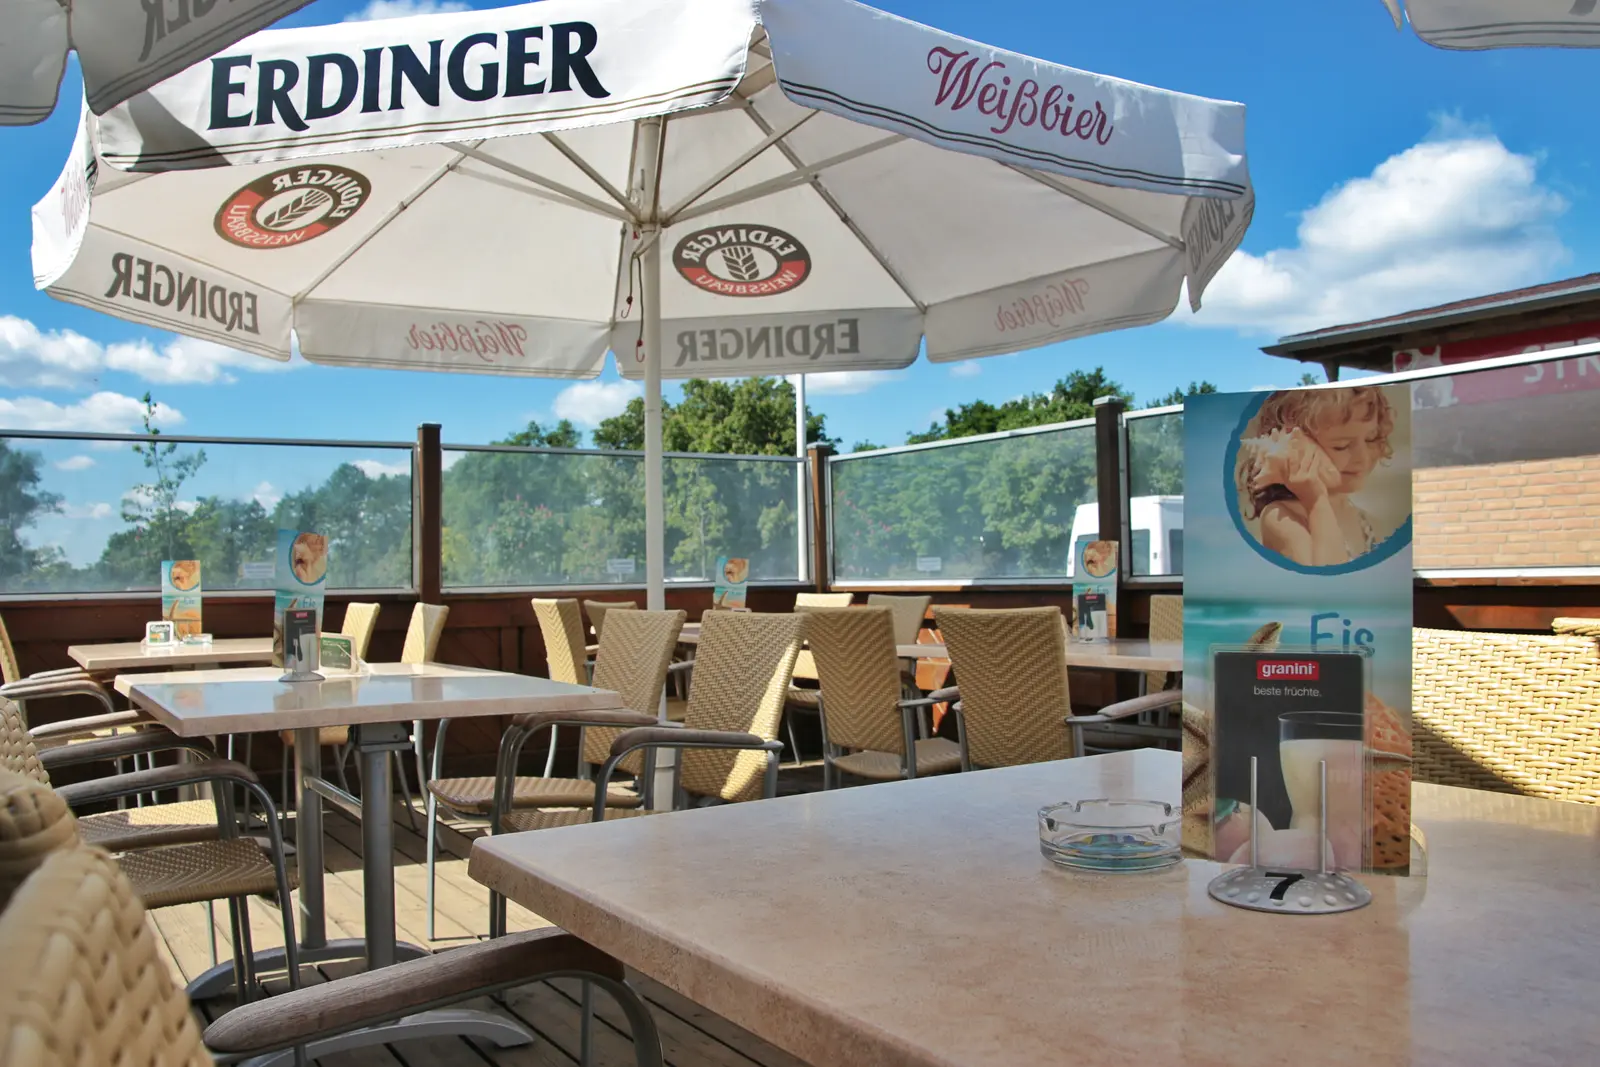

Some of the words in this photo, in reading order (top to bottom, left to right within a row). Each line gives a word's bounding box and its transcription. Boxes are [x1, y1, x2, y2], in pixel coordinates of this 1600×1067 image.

[206, 21, 610, 131] ERDINGER
[927, 46, 1114, 145] Weißbier
[1310, 612, 1376, 658] Eis
[1262, 663, 1313, 677] granini
[1253, 686, 1282, 696] beste
[1264, 871, 1305, 901] 7
